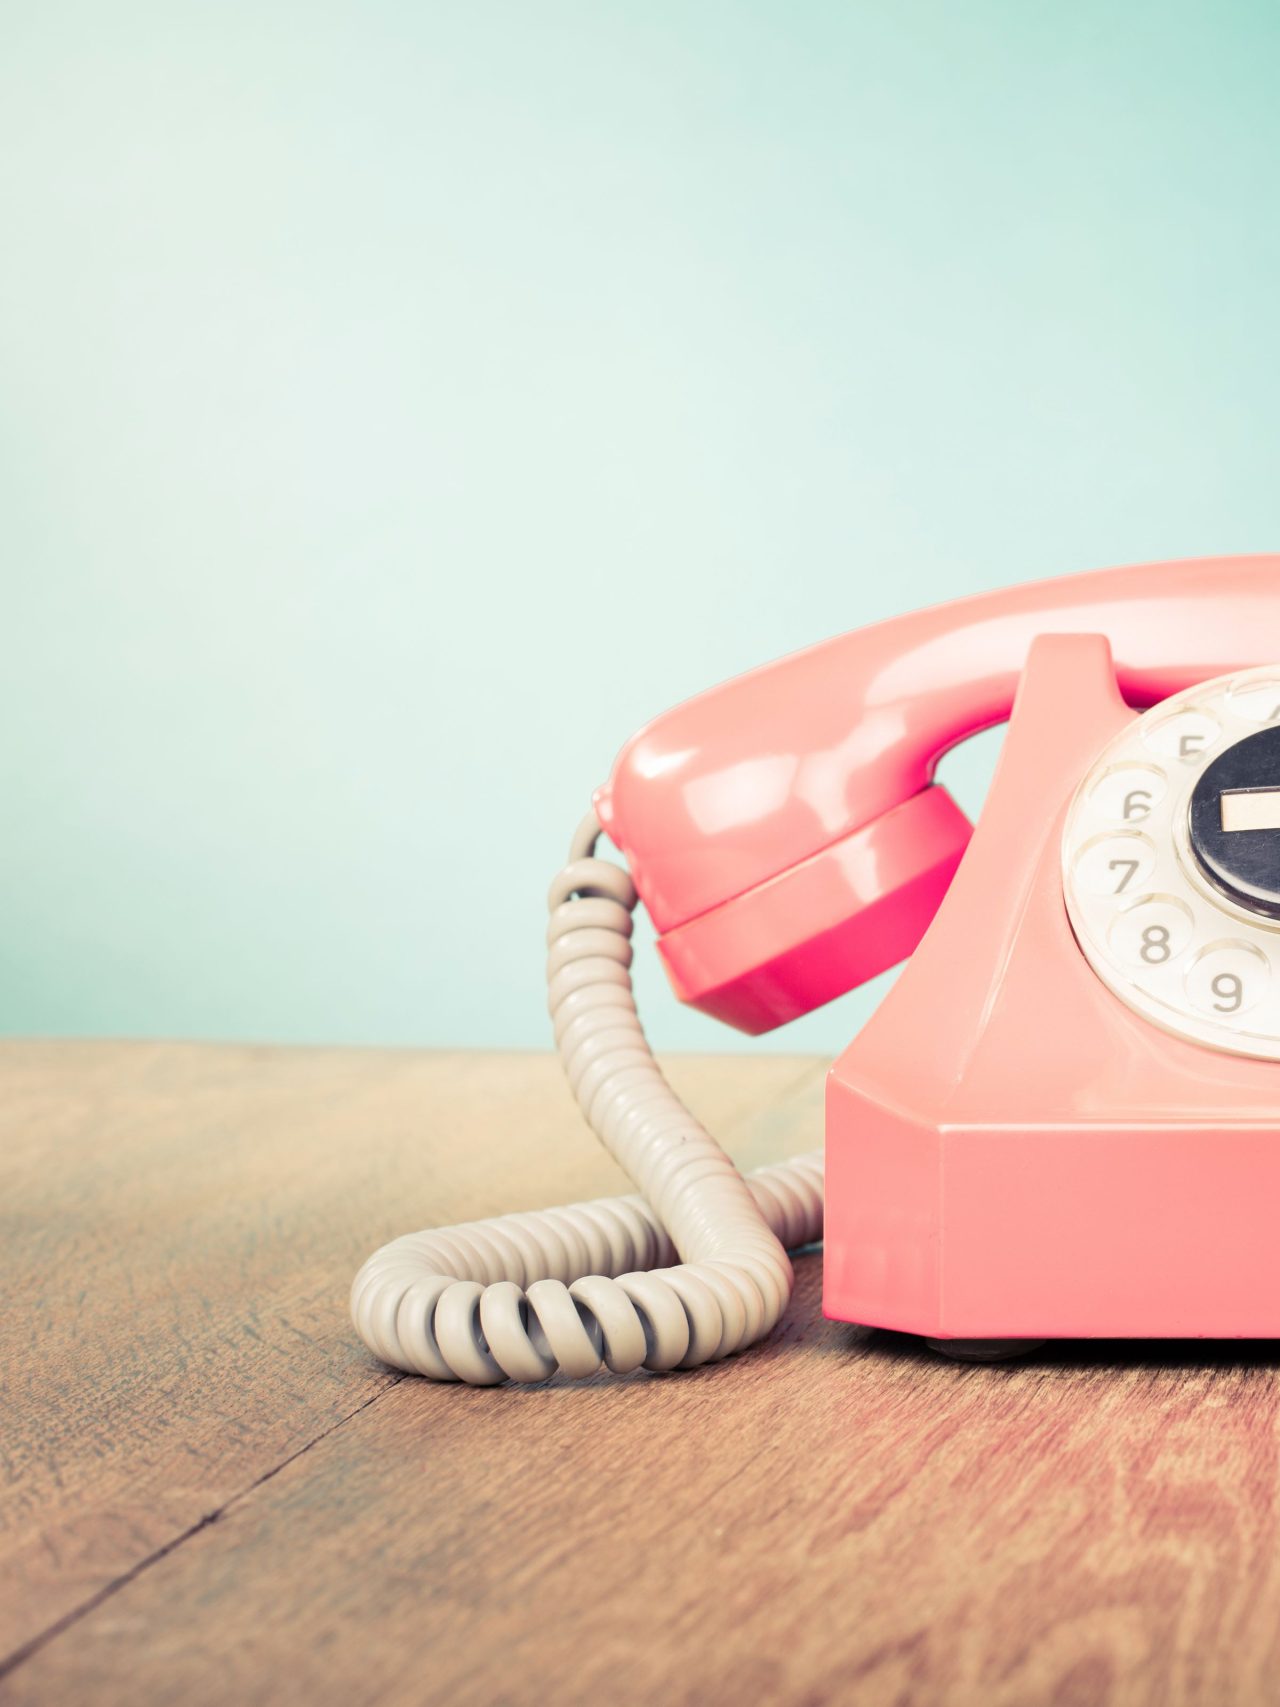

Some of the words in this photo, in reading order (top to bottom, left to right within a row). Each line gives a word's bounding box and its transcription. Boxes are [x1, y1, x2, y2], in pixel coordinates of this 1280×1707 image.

[1179, 735, 1206, 766] 5
[1123, 790, 1152, 824] 6
[1108, 860, 1140, 894] 7
[1140, 925, 1171, 964] 8
[1211, 973, 1243, 1012] 9
